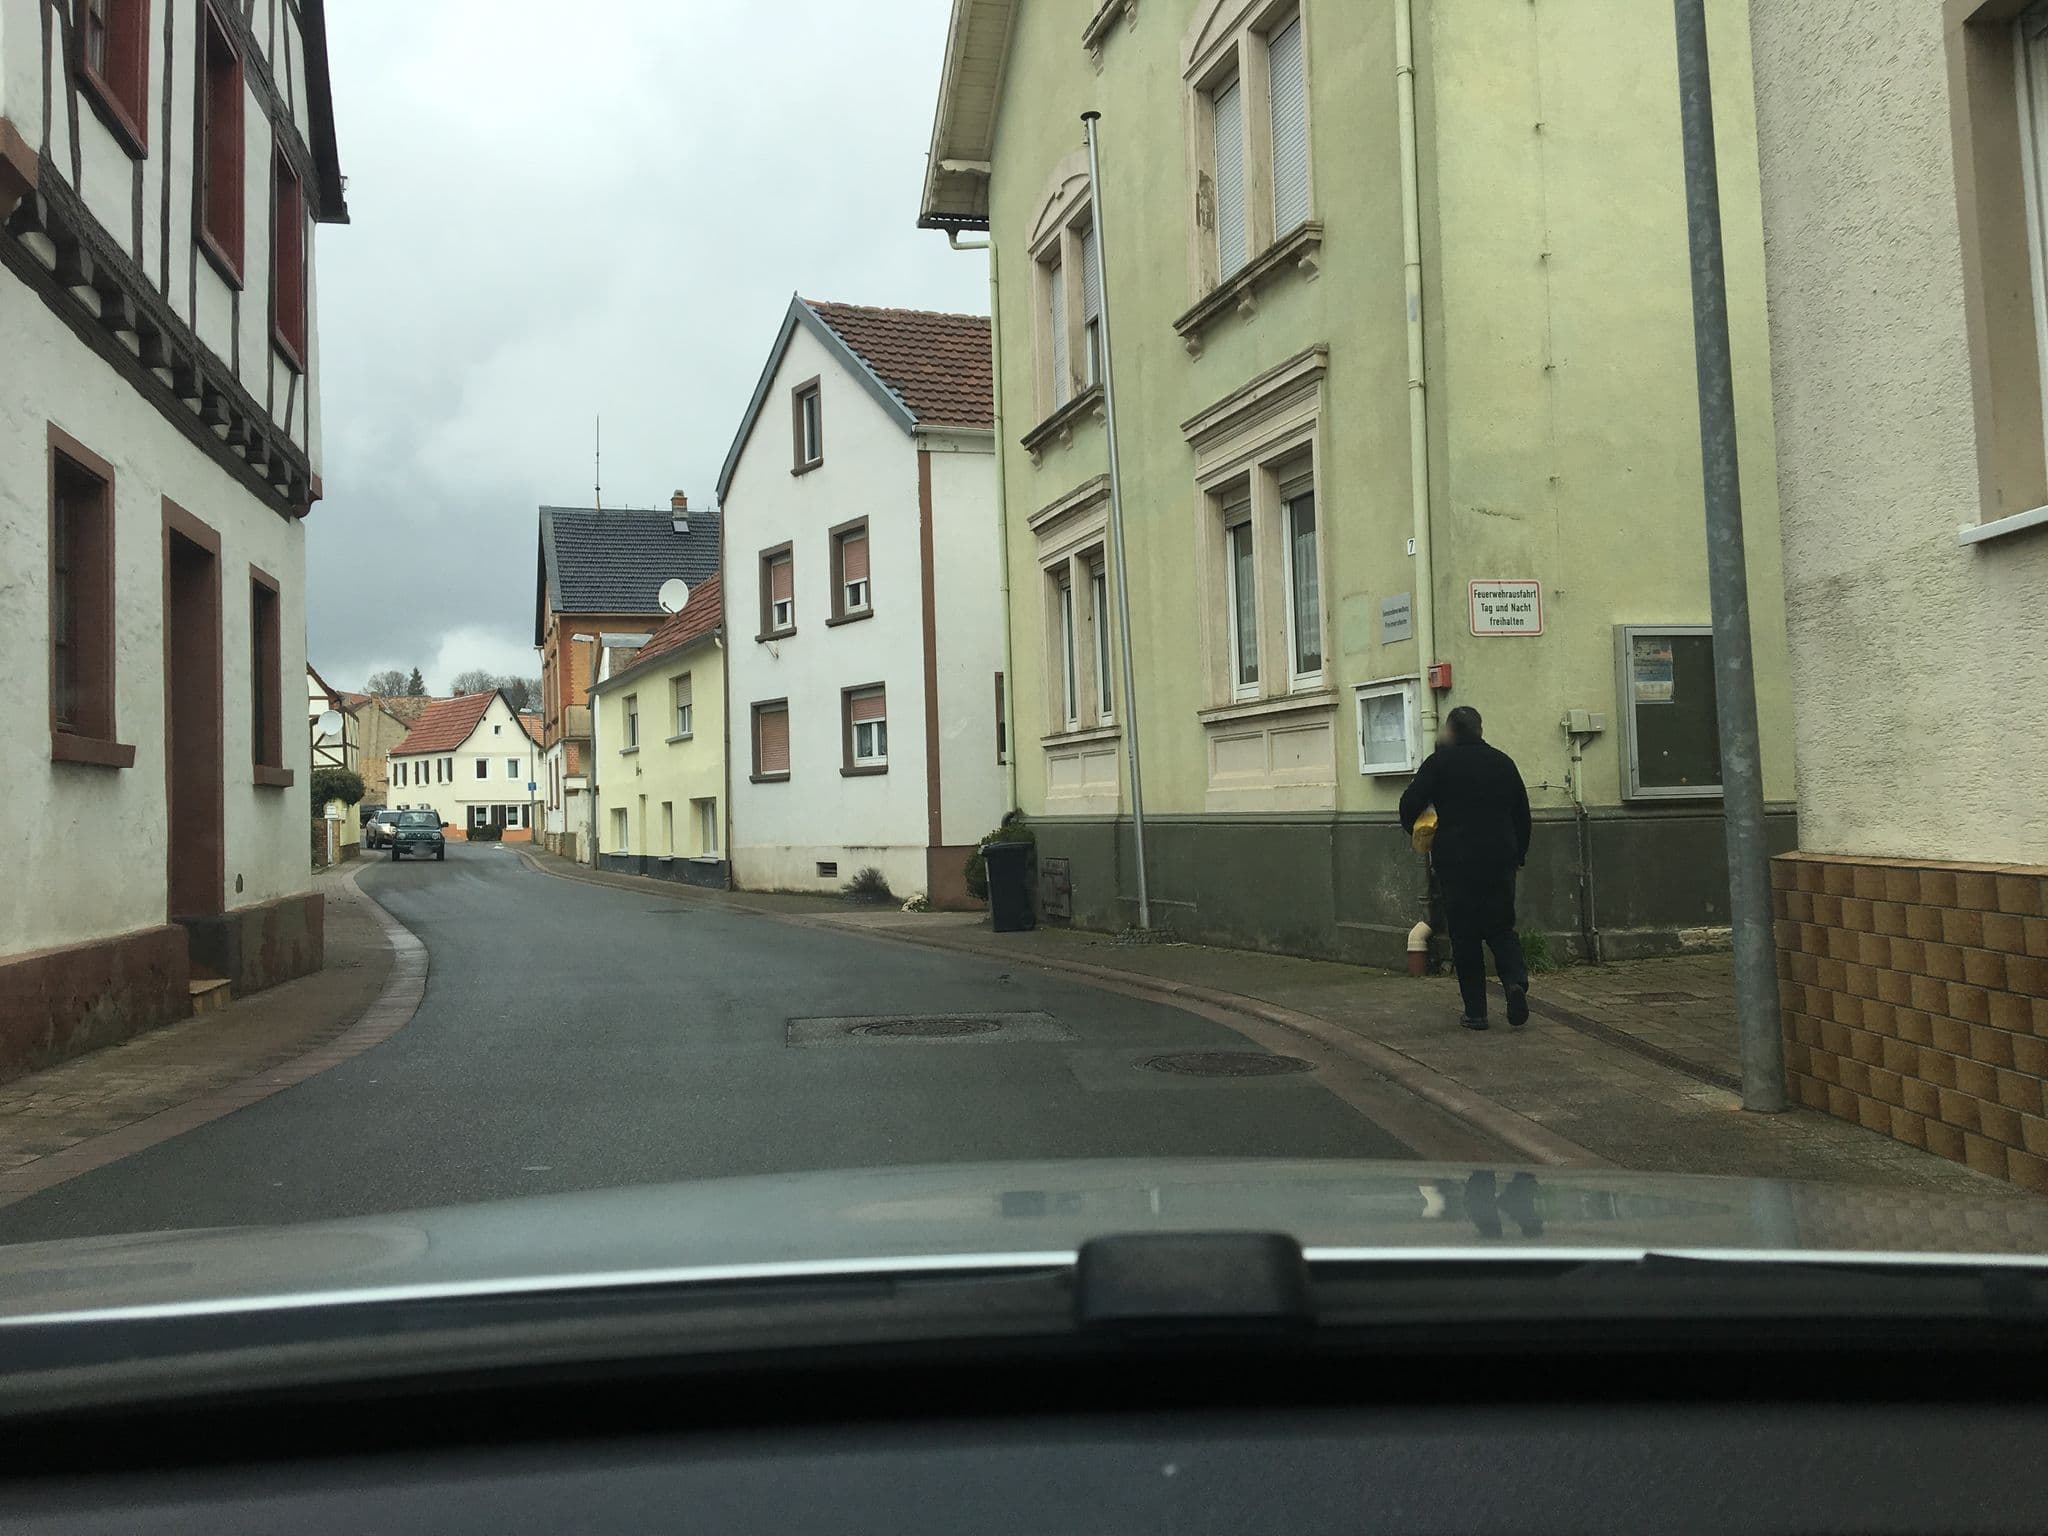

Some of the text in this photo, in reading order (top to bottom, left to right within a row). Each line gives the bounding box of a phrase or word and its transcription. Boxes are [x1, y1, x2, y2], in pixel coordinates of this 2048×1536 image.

[1409, 539, 1414, 553] 7
[1473, 589, 1537, 599] Feuerwehrausfahrt
[1481, 603, 1532, 614] Tag und Nacht
[1489, 617, 1525, 626] freihalten
